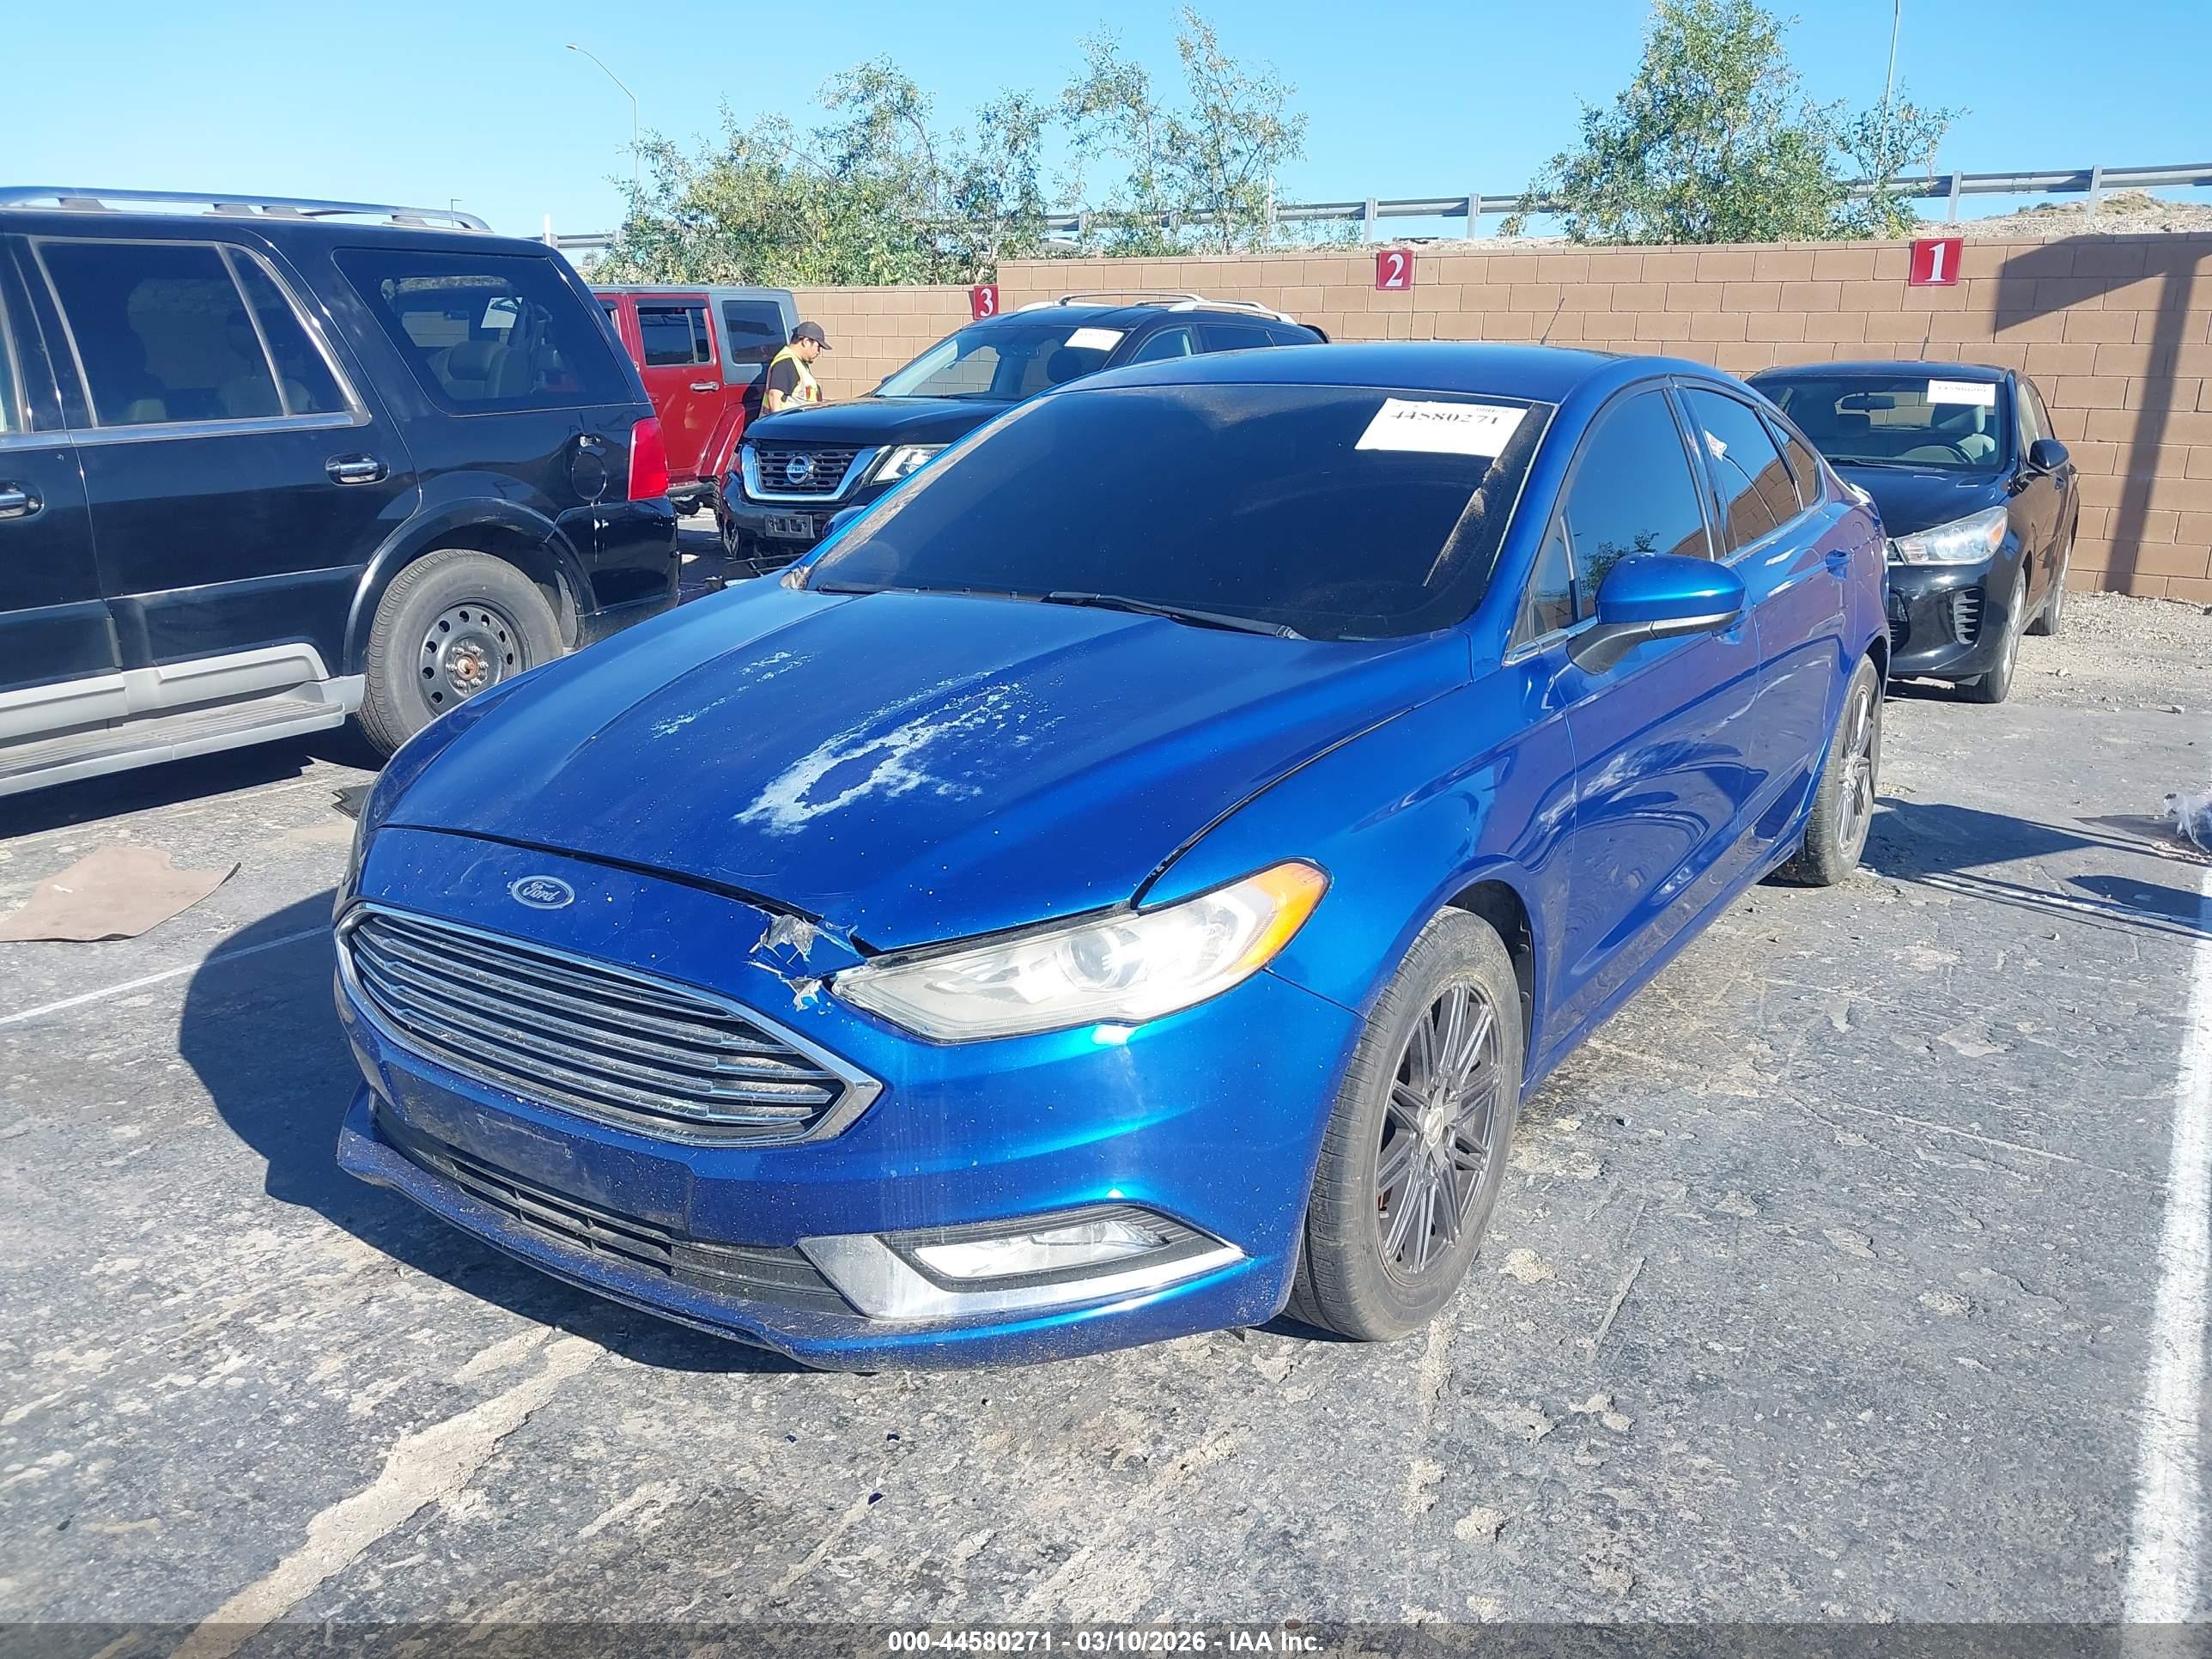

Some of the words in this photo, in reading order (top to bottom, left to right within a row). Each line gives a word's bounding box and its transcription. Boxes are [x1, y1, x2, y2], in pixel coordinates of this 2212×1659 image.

[1384, 253, 1404, 287] 2
[1923, 241, 1947, 282] 1
[979, 288, 994, 317] 3
[522, 881, 561, 902] Ford
